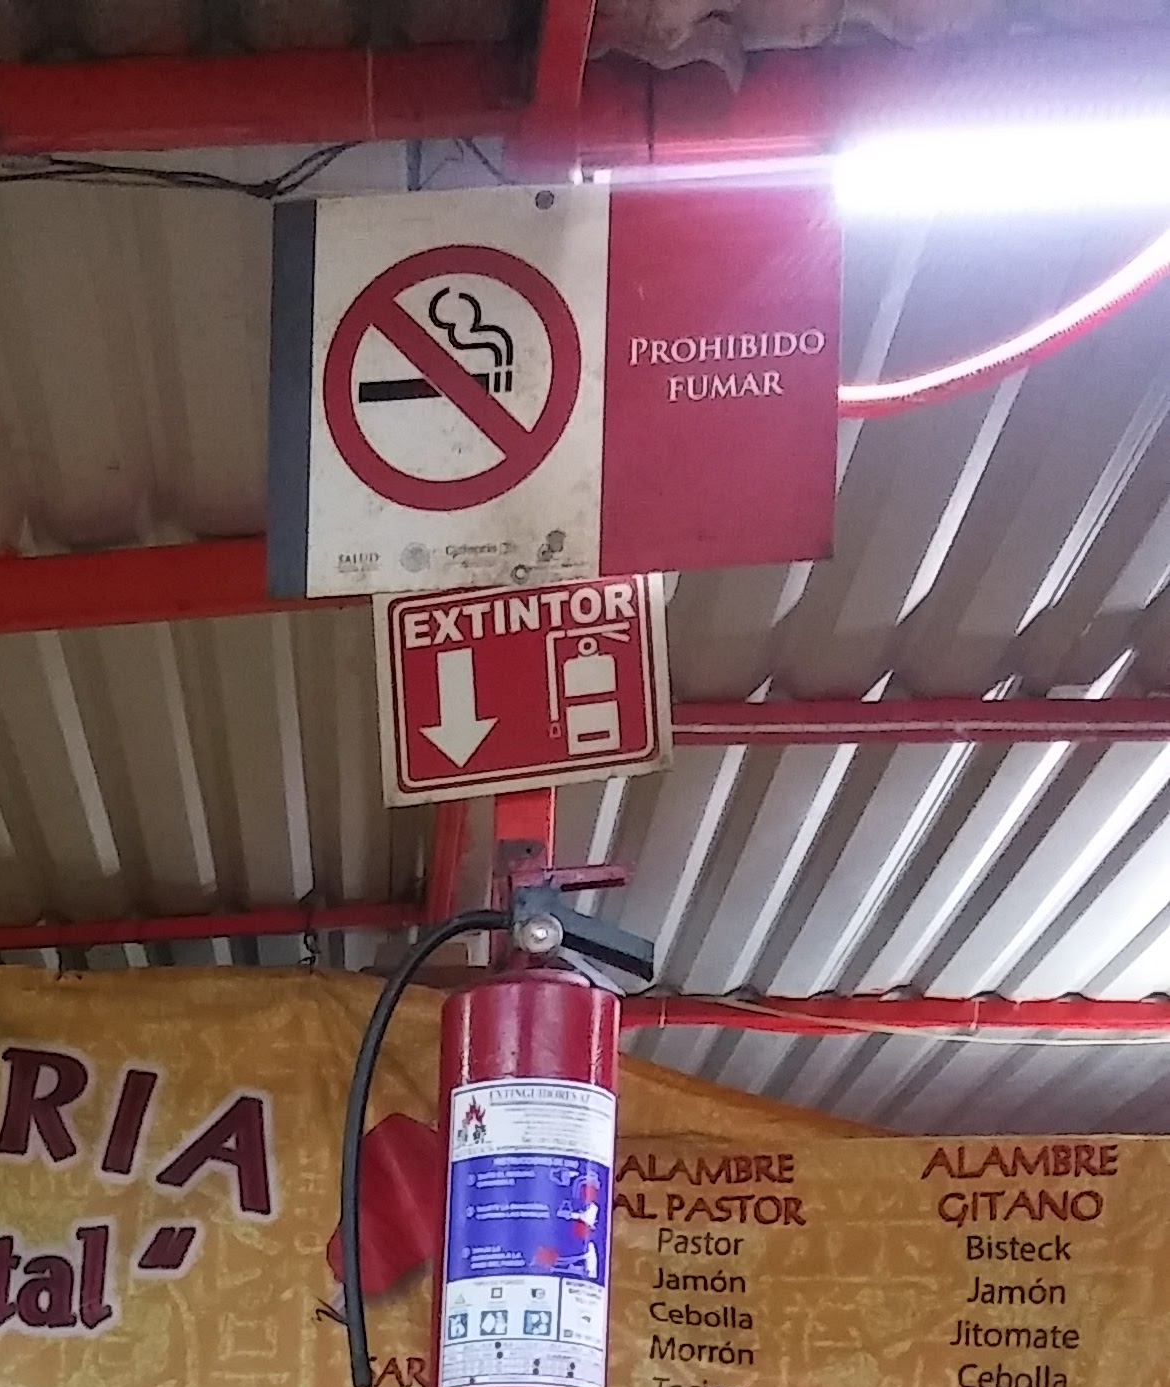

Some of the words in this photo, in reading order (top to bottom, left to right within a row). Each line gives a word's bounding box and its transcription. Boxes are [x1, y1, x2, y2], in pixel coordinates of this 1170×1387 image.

[631, 328, 825, 366] PROHIBIDO
[668, 371, 783, 402] FUMAR
[404, 583, 636, 649] EXTINTOR
[616, 1153, 794, 1185] ALAMBRE
[921, 1144, 1118, 1179] ALAMBRE
[612, 1193, 658, 1220] AL
[667, 1194, 806, 1226] PASTOR
[938, 1190, 1103, 1228] GITANO
[658, 1228, 744, 1255] Pastor
[967, 1235, 1071, 1261] Bisteck
[653, 1268, 745, 1293] Jamón
[967, 1277, 1065, 1304] Jamón
[650, 1302, 753, 1329] Cebolla
[950, 1320, 1079, 1349] Jitomate
[650, 1335, 753, 1365] Morrón
